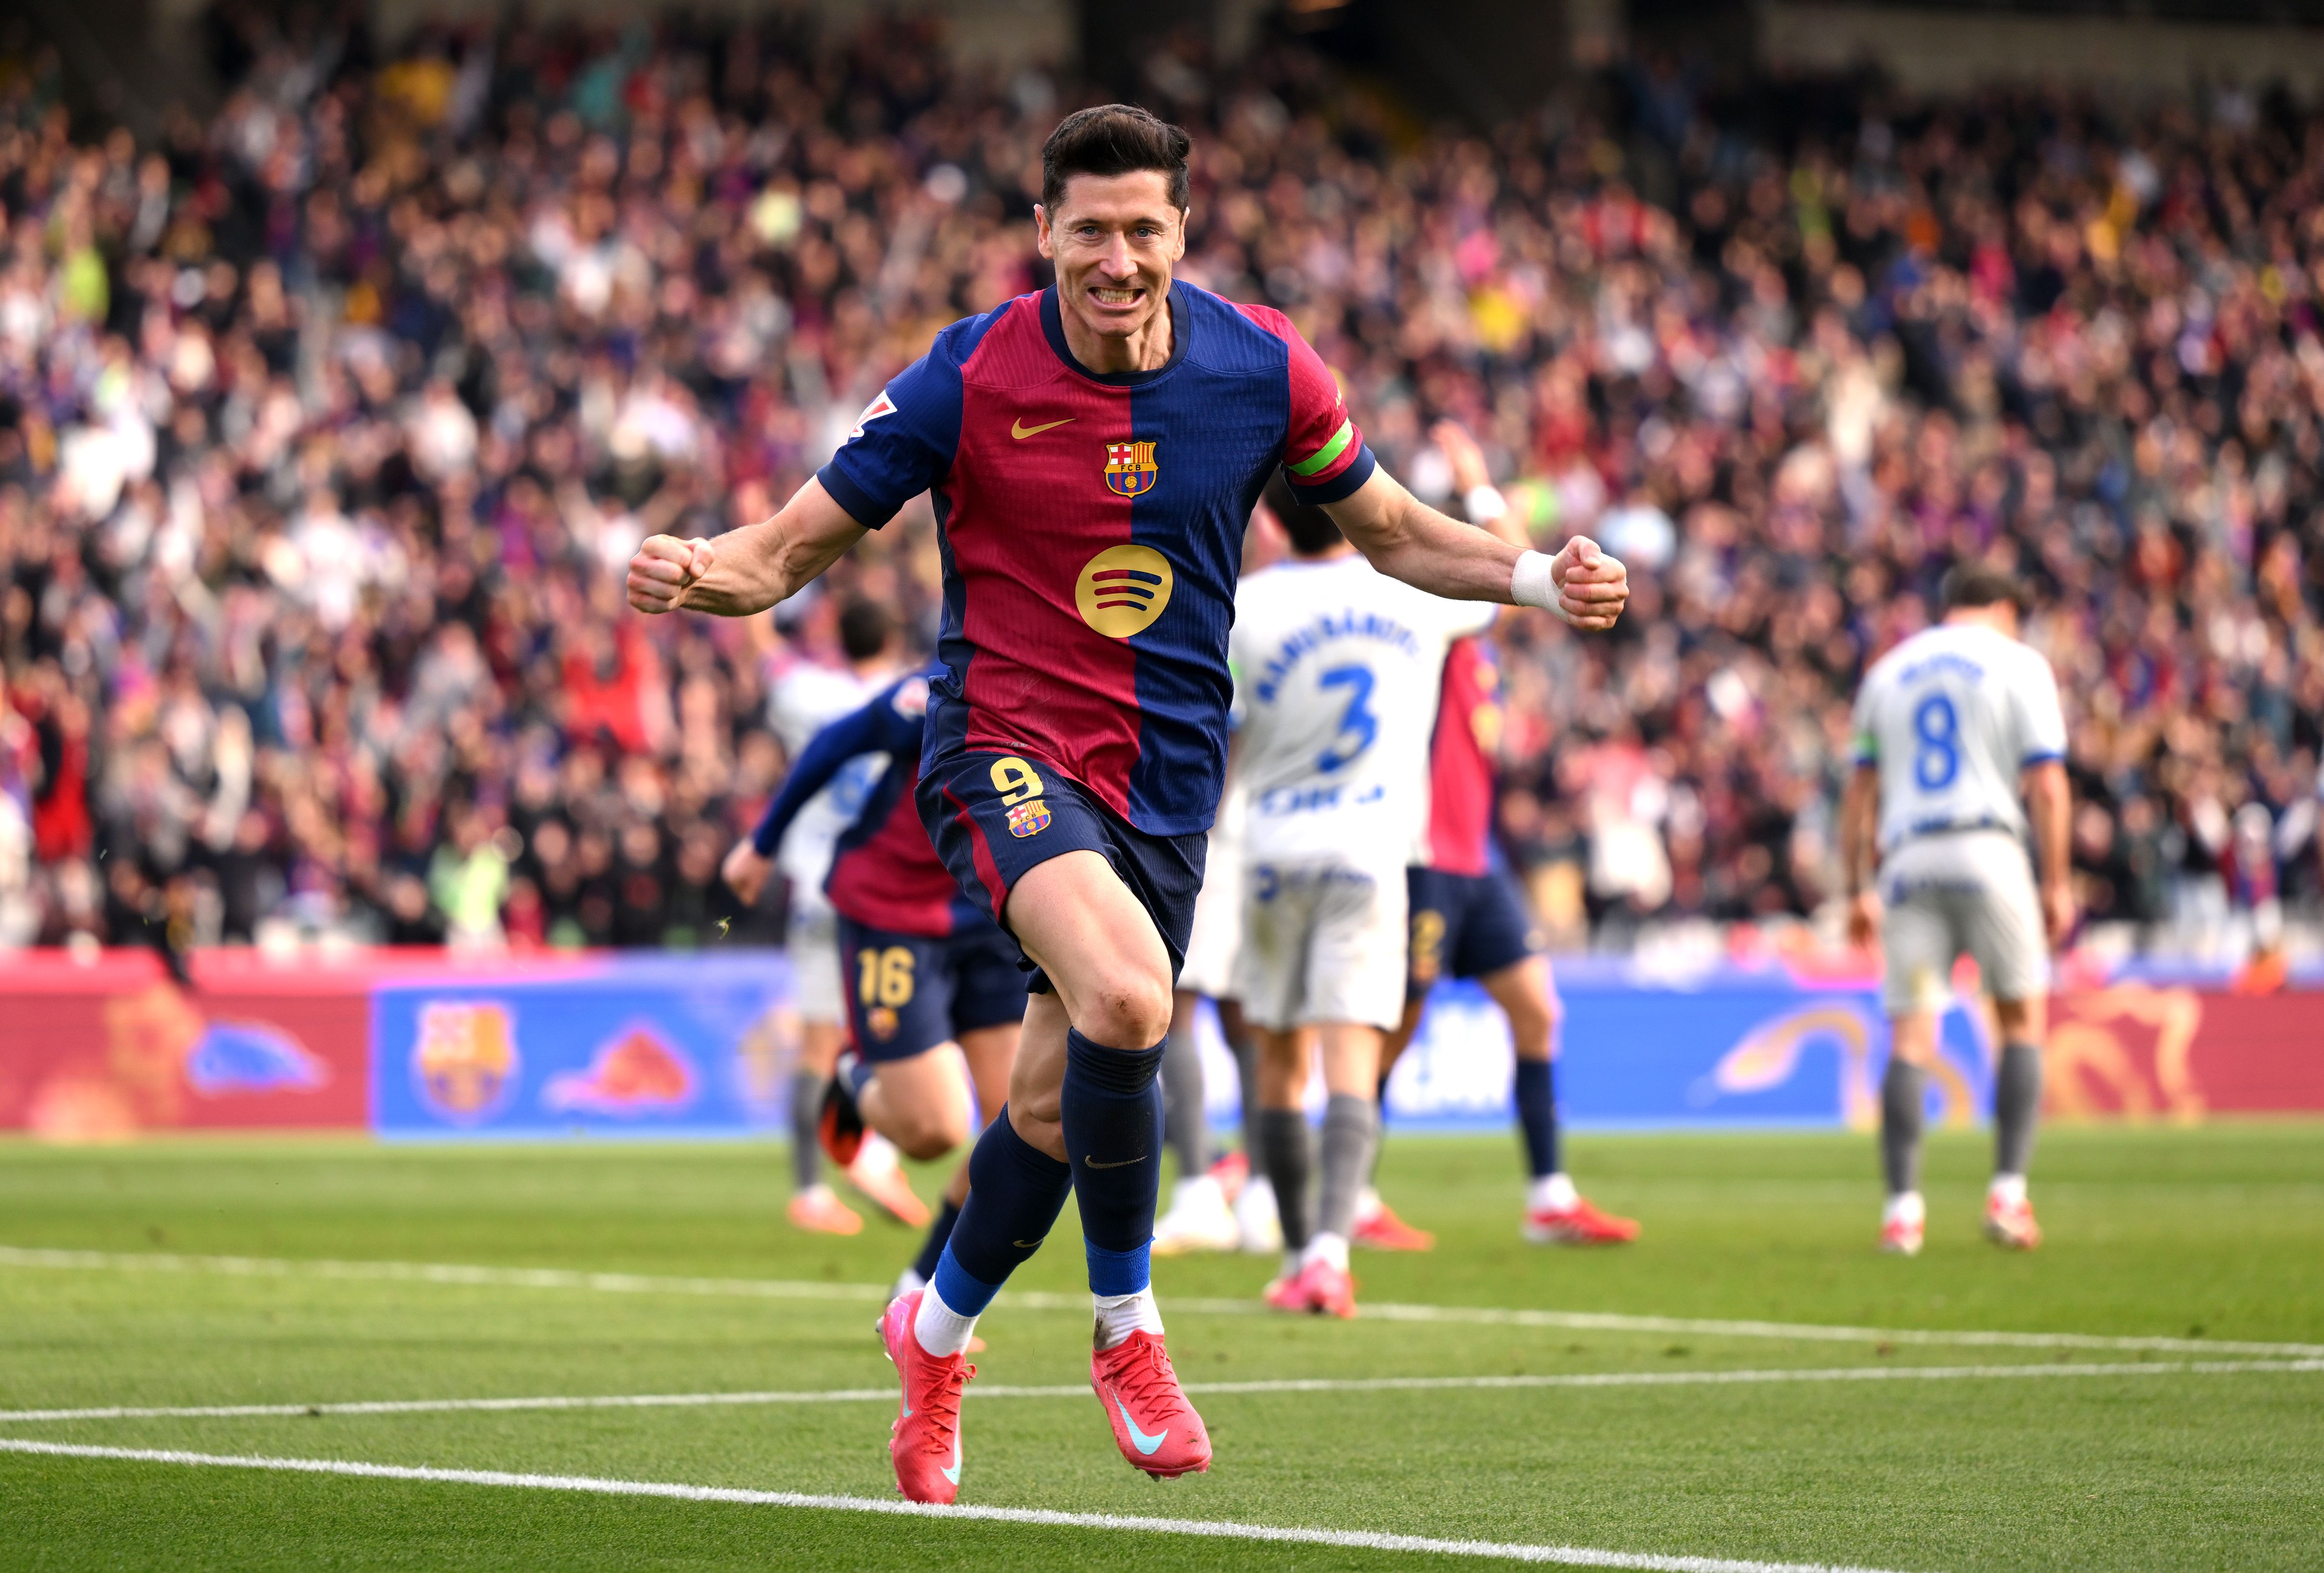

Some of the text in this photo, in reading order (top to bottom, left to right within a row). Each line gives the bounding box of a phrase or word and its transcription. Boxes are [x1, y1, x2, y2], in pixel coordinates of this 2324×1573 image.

[1318, 664, 1378, 773] 3
[1915, 694, 1959, 795] 8
[990, 757, 1044, 807] 9
[1020, 813, 1037, 823] FCB
[858, 946, 915, 1007] 16
